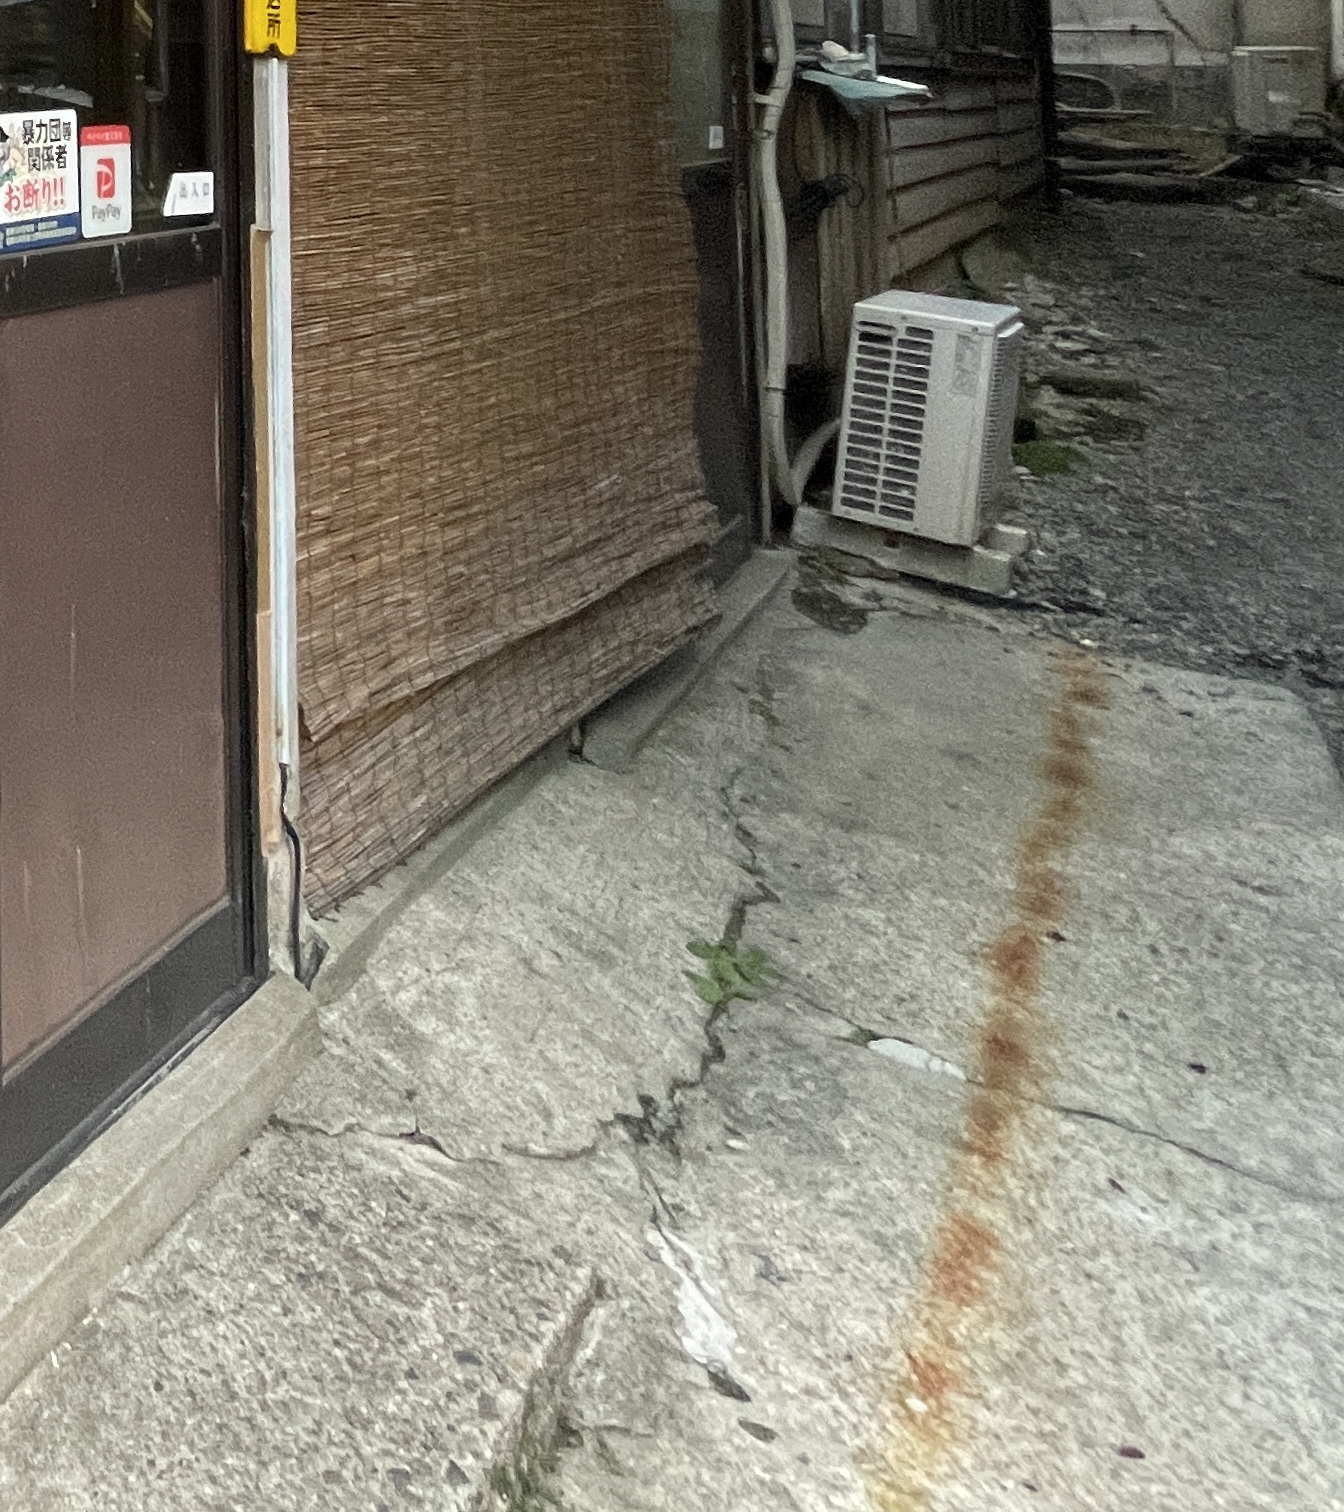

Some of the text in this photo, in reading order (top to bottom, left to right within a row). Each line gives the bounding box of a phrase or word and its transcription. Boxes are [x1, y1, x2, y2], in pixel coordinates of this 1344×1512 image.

[27, 144, 68, 172] 関係者
[92, 203, 122, 222] PayPay
